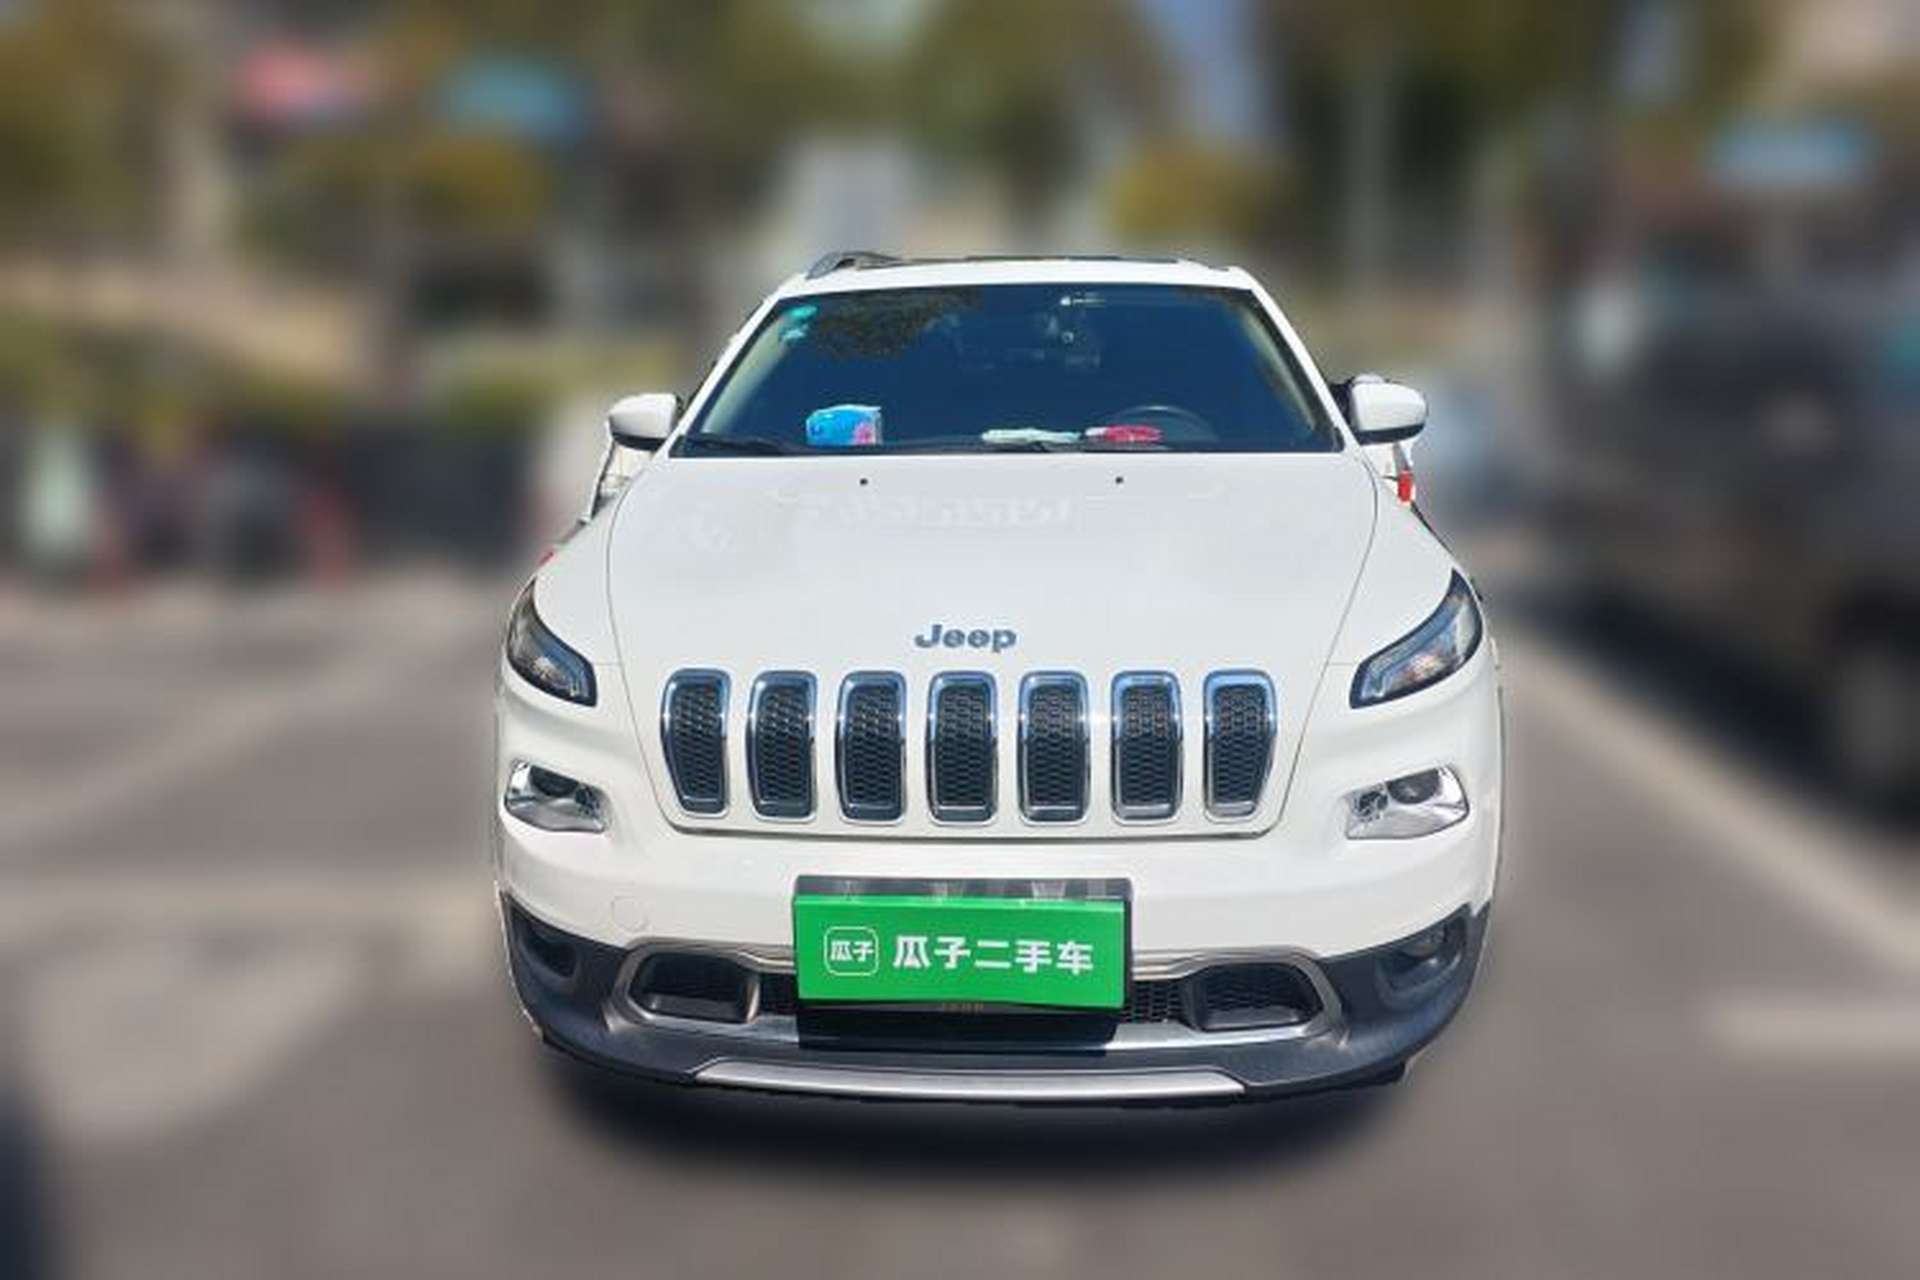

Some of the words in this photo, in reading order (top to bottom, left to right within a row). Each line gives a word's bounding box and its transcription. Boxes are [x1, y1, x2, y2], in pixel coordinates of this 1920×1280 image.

[914, 624, 1017, 653] Jeep
[829, 941, 875, 962] 瓜子
[893, 935, 1094, 975] 瓜子二手车
